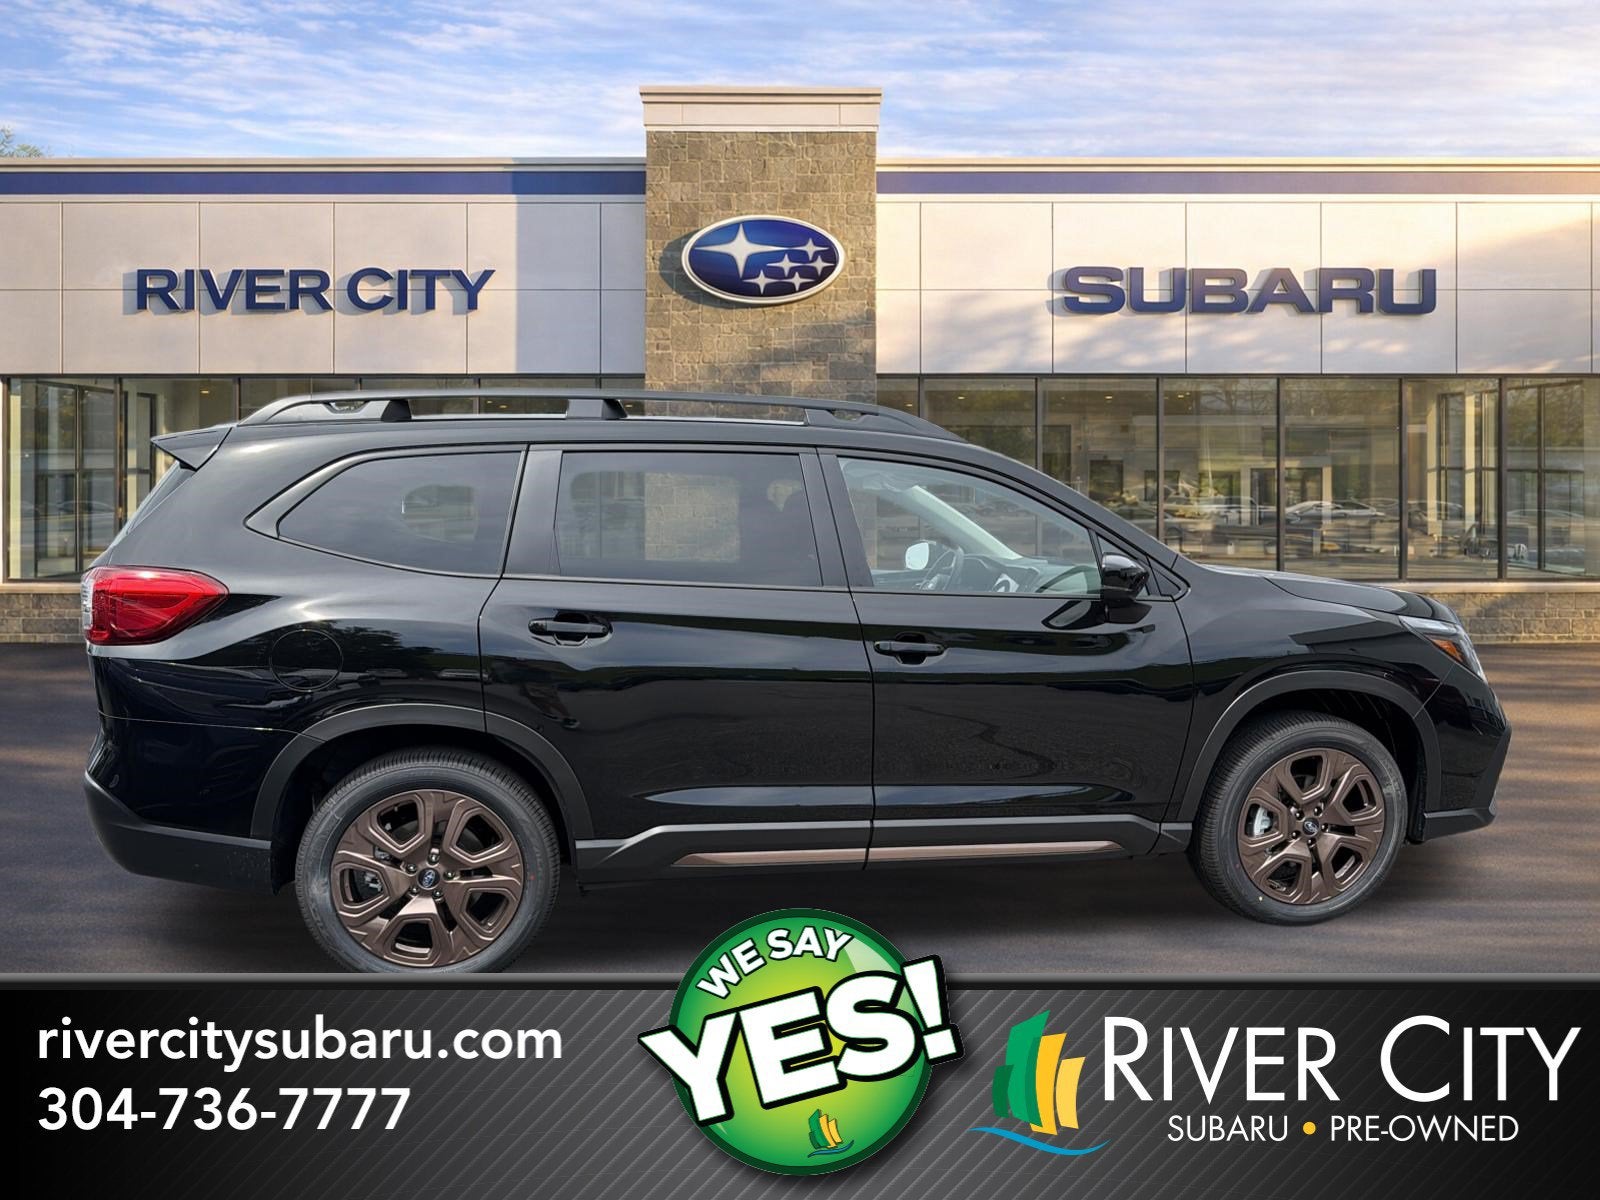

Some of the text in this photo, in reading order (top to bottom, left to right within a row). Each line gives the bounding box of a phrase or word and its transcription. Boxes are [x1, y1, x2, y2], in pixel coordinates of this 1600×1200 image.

[136, 267, 496, 311] RIVER CITY
[1063, 266, 1437, 315] SUBARU
